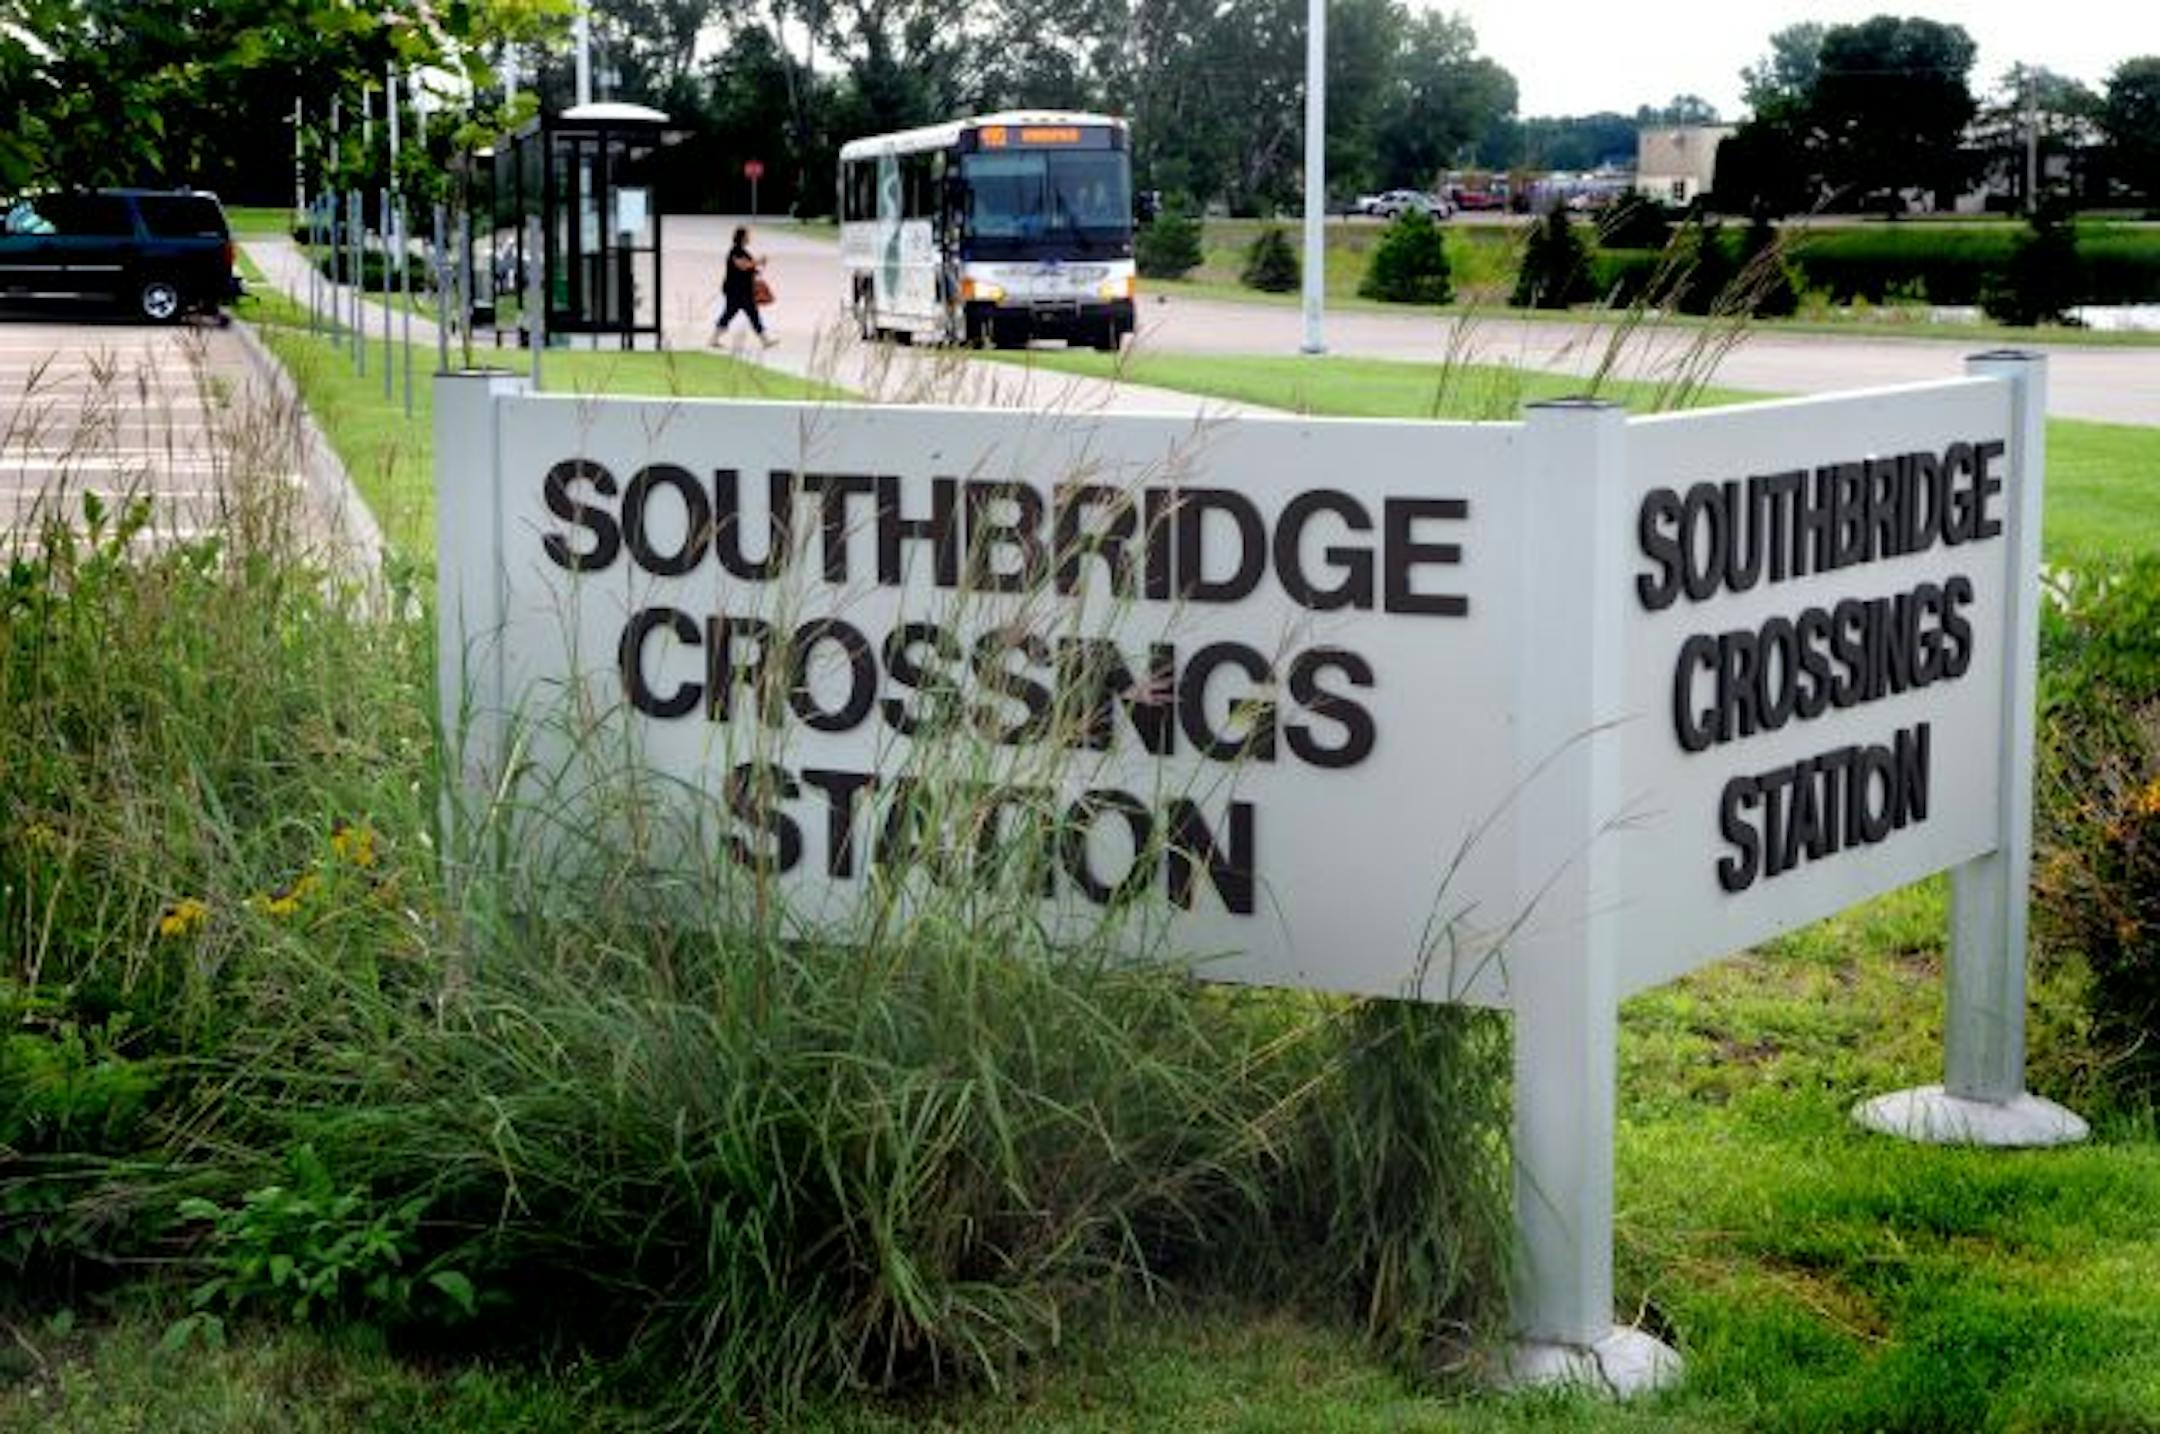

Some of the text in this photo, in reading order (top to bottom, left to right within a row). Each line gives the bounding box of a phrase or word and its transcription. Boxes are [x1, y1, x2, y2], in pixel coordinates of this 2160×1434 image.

[541, 458, 1471, 618] SOUTHBRIDGE
[1636, 439, 2005, 612] SOUTHBRIDGE
[1673, 576, 1974, 754] CROSSINGS
[1716, 722, 1930, 893] STATION
